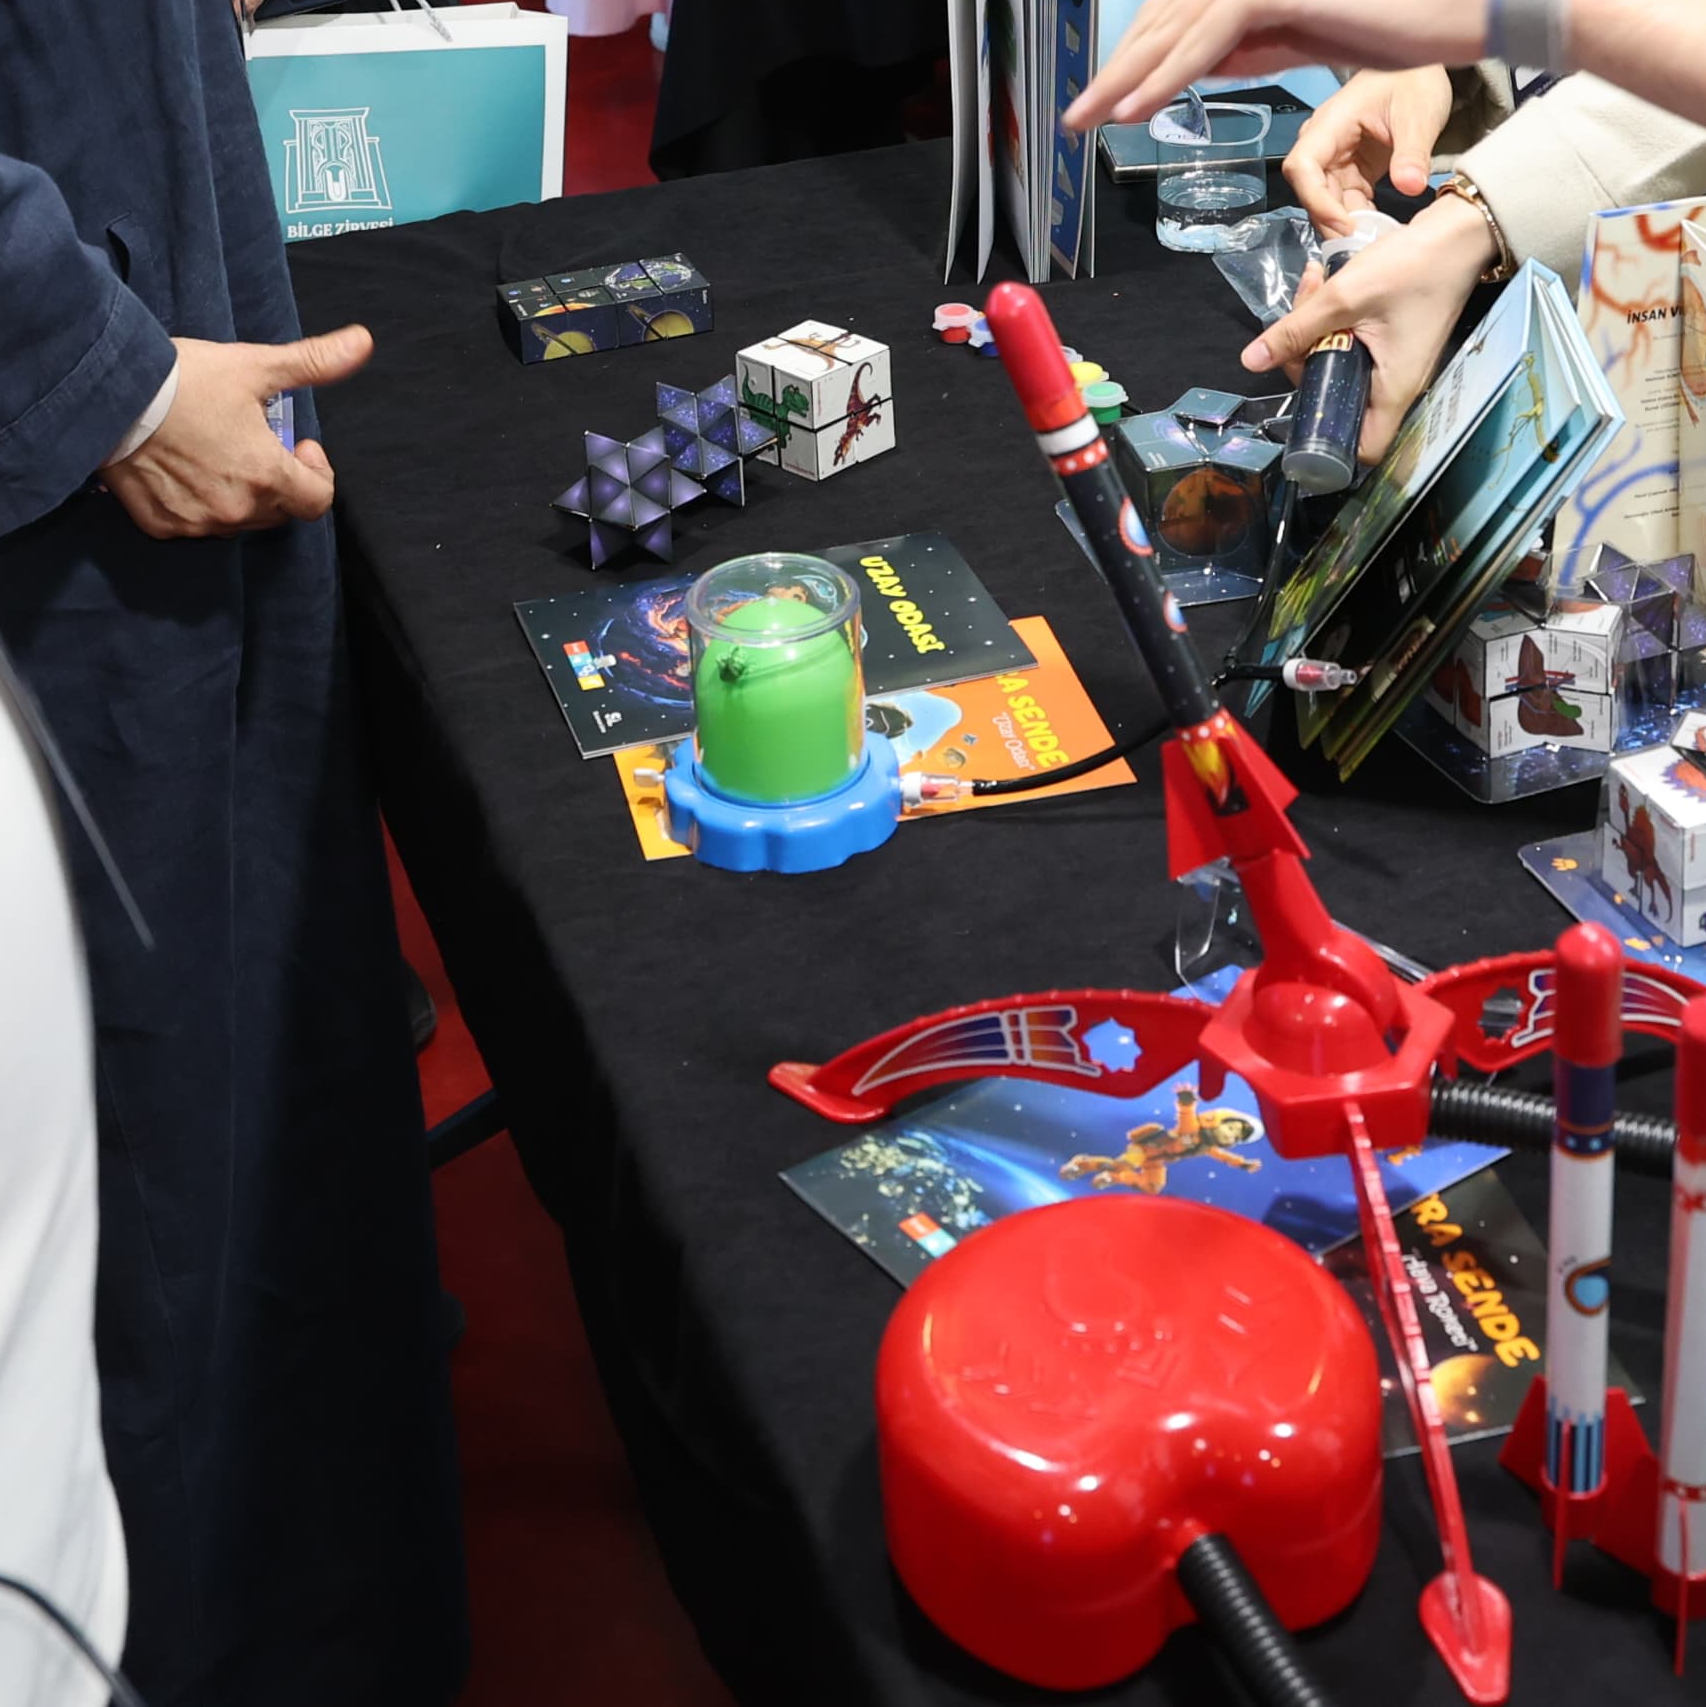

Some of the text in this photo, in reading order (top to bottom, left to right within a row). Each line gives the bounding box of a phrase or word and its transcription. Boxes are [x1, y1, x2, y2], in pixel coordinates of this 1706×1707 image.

[287, 220, 334, 240] BİLGE
[1627, 307, 1668, 326] İNSAN
[860, 556, 946, 654] UZAY ODASI
[1008, 695, 1070, 768] SENDE
[1443, 1250, 1542, 1368] SENDE
